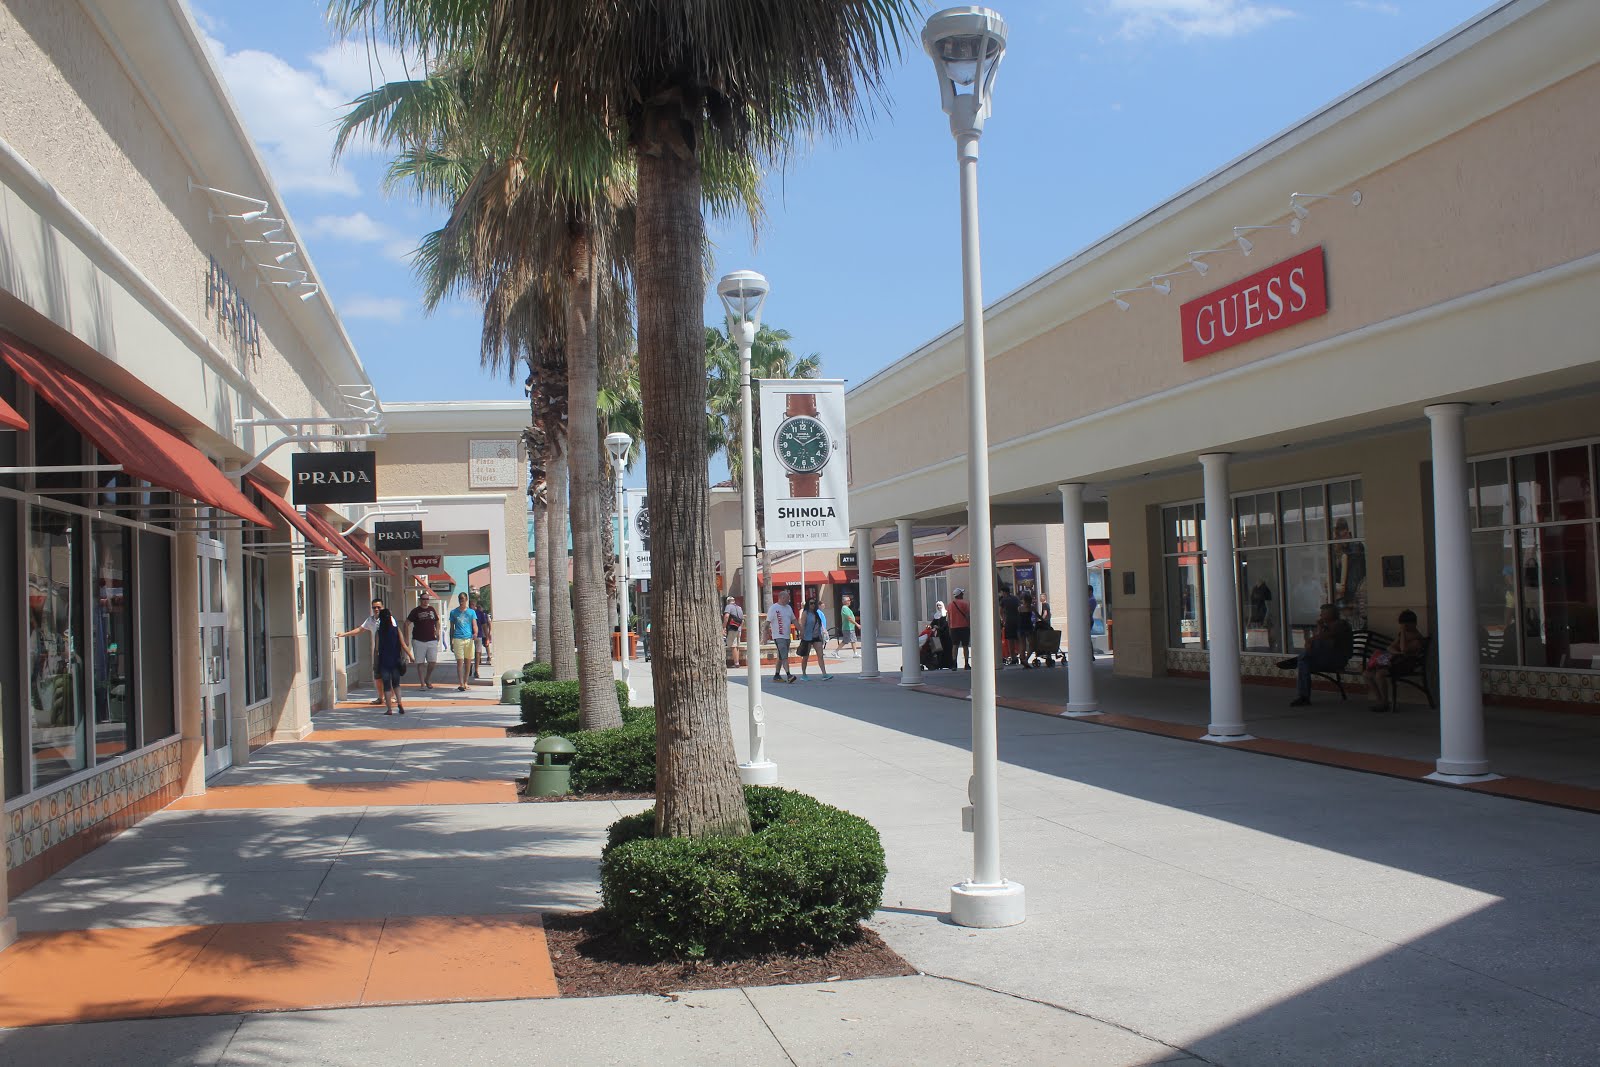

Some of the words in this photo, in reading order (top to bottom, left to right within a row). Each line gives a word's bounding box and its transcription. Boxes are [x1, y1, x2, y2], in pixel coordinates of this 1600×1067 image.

[1195, 266, 1307, 345] GUESS
[297, 470, 371, 485] PRADA
[778, 506, 836, 519] SHINOLA
[790, 519, 826, 528] DETROIT
[378, 531, 420, 541] PRADA
